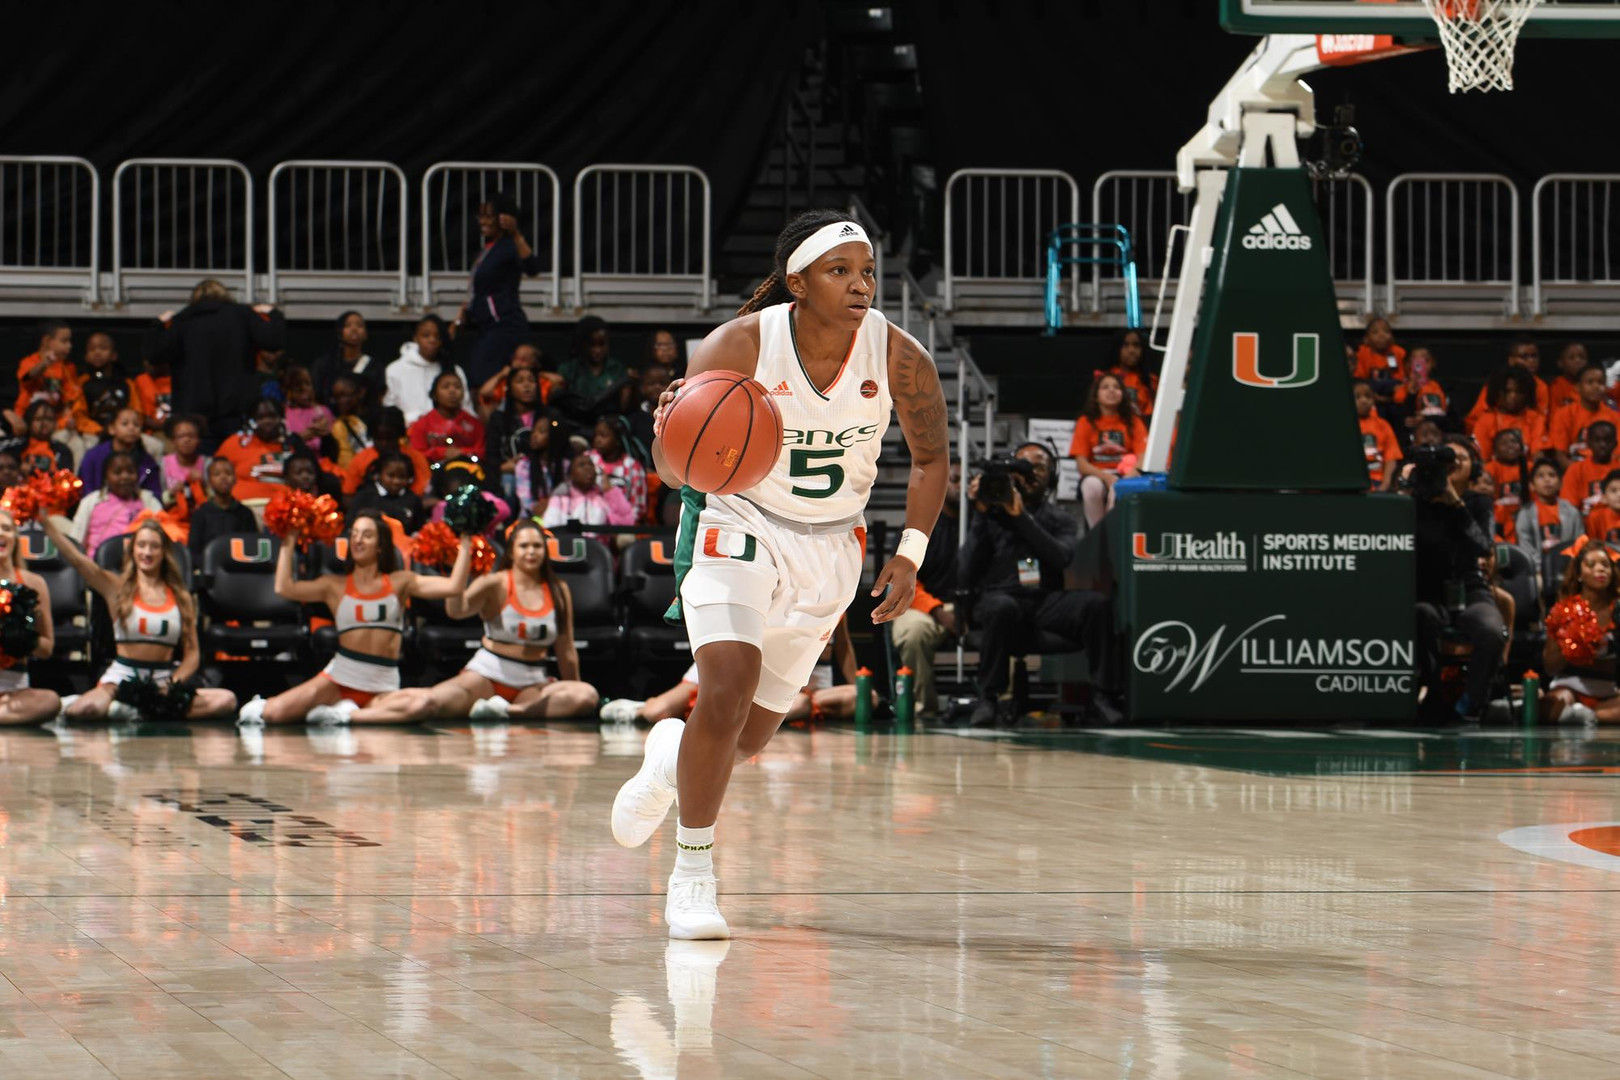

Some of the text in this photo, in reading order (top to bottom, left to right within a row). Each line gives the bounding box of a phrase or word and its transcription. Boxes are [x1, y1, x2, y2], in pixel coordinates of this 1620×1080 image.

[1242, 233, 1312, 250] adidas
[1232, 332, 1319, 388] U
[770, 387, 793, 396] adidas
[783, 422, 879, 448] anes
[789, 448, 845, 499] 5
[230, 537, 272, 563] U
[548, 538, 587, 562] U
[703, 527, 757, 562] U
[1263, 534, 1416, 551] SPORTS MEDICINE
[1263, 555, 1357, 571] INSTITUTE
[1133, 614, 1414, 692] WILLIAMSON
[1315, 675, 1412, 693] CADILLAC
